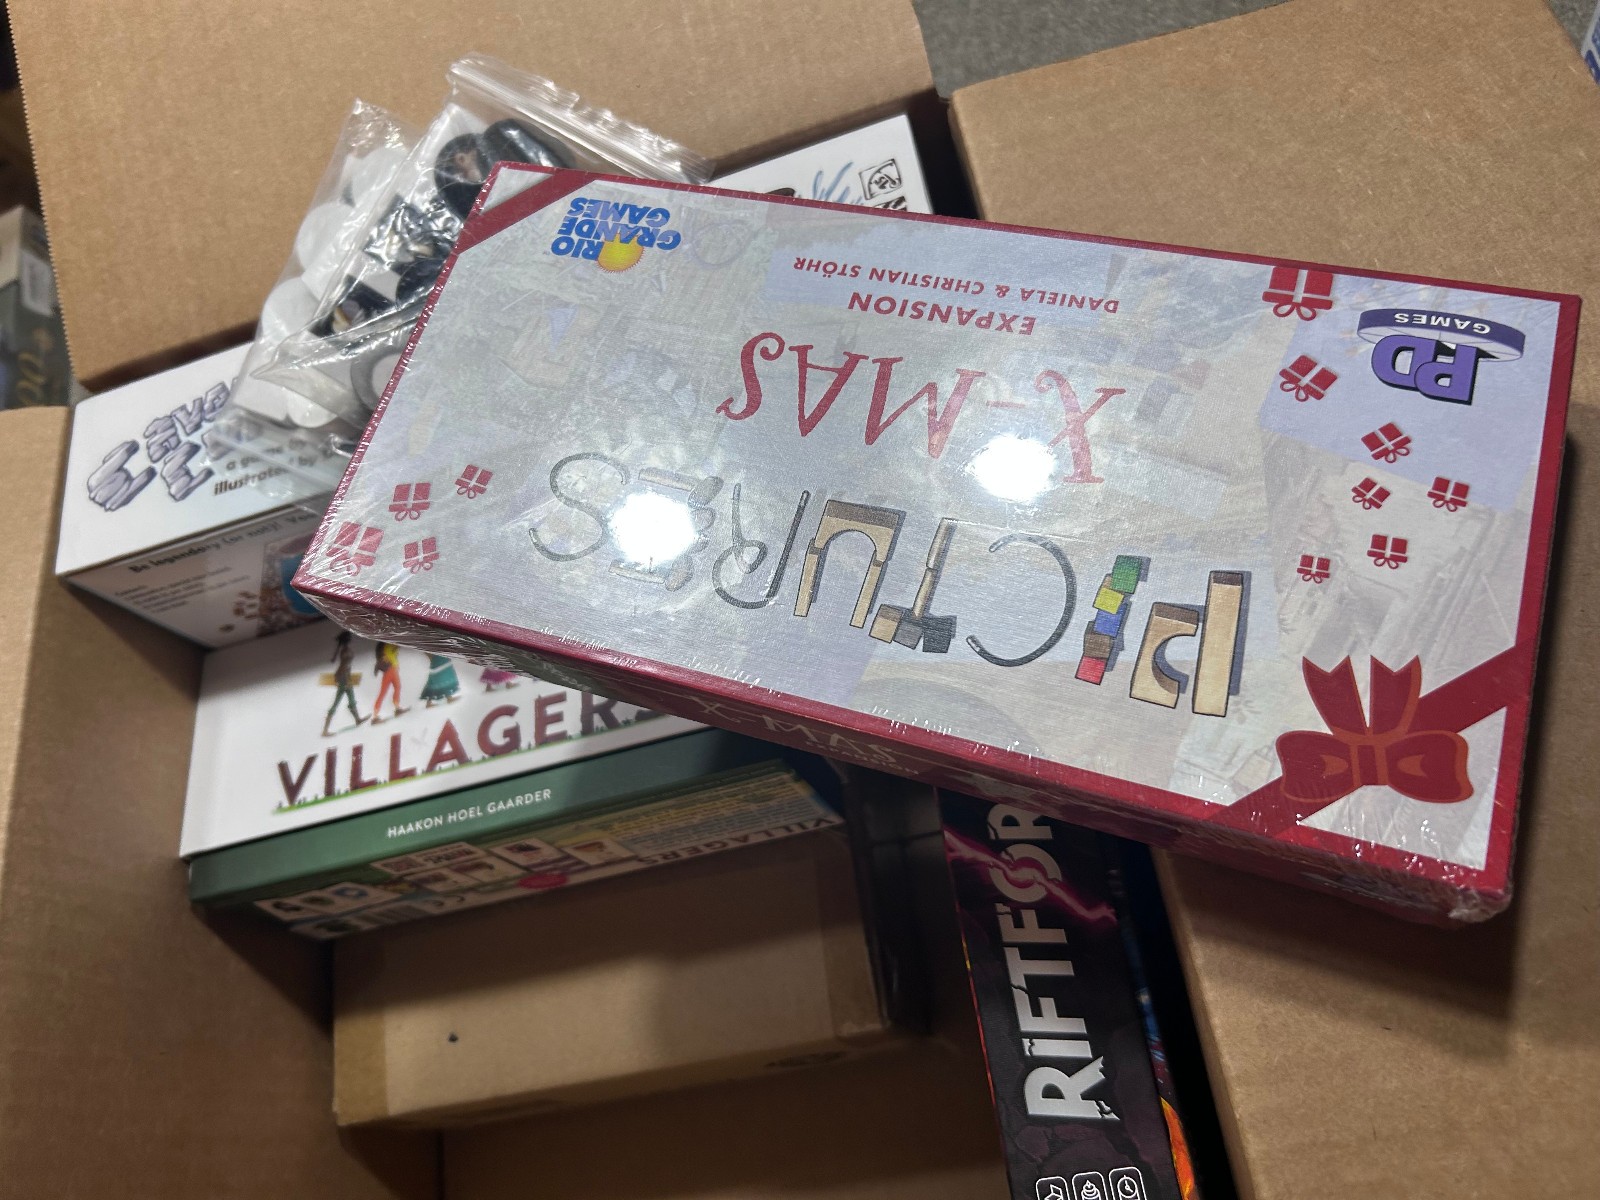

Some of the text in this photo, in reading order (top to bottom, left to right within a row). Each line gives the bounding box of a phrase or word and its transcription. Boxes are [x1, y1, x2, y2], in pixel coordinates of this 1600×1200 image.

[547, 197, 670, 228] GAMES
[558, 215, 681, 250] GRANDE
[551, 235, 604, 260] RIO
[793, 257, 1119, 314] DANIELA & CHRISTIAN STÖHR
[847, 291, 1037, 335] EXPANSION
[1394, 312, 1491, 335] GAMES
[716, 332, 1126, 484] X-MAS
[529, 452, 1246, 717] PICTURES
[277, 690, 661, 806] VILLAGER
[688, 695, 897, 763] X-MAS
[388, 788, 551, 838] HAAKON HOEL GAARDER
[638, 818, 834, 865] VILLAGERS
